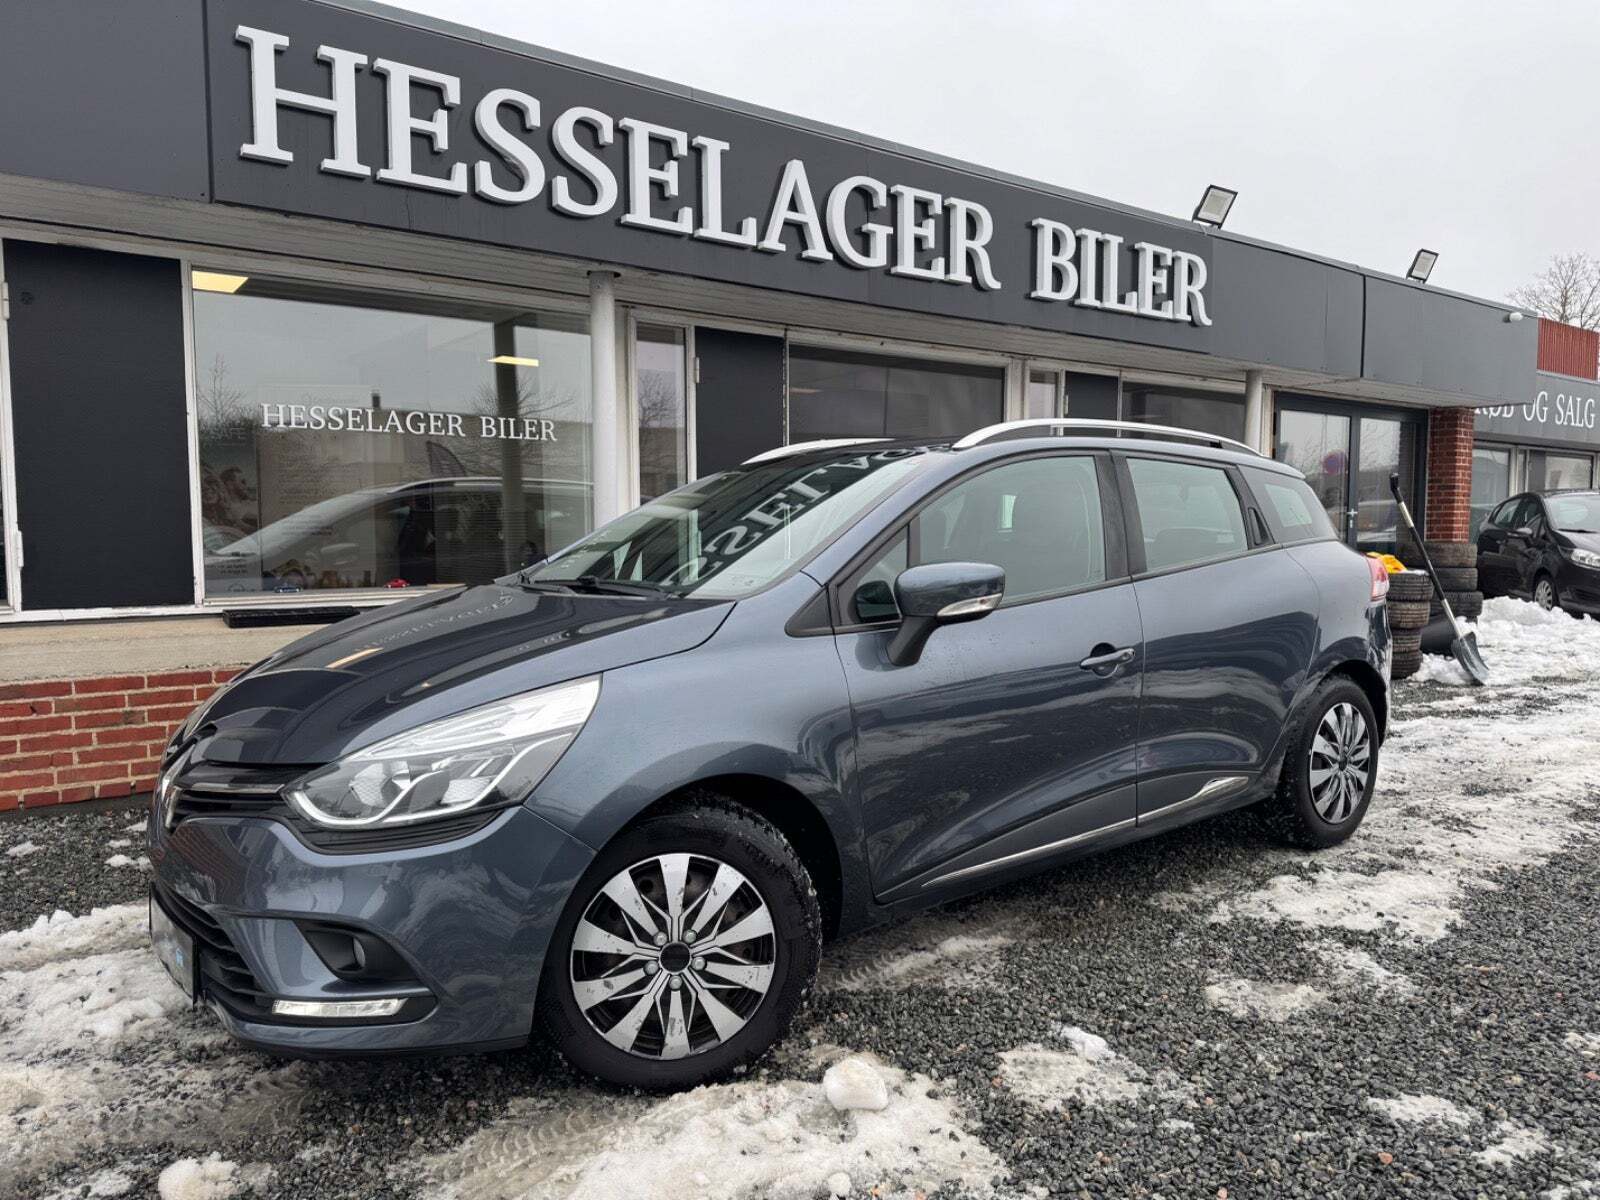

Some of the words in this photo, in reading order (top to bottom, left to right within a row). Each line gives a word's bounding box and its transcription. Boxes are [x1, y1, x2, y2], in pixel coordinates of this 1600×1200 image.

[235, 24, 1003, 291] HESSELAGER
[1030, 217, 1213, 327] BILER
[260, 403, 466, 438] HESSELAGER
[480, 416, 558, 442] BILER
[1523, 391, 1548, 423] OG
[1555, 393, 1596, 429] SALG
